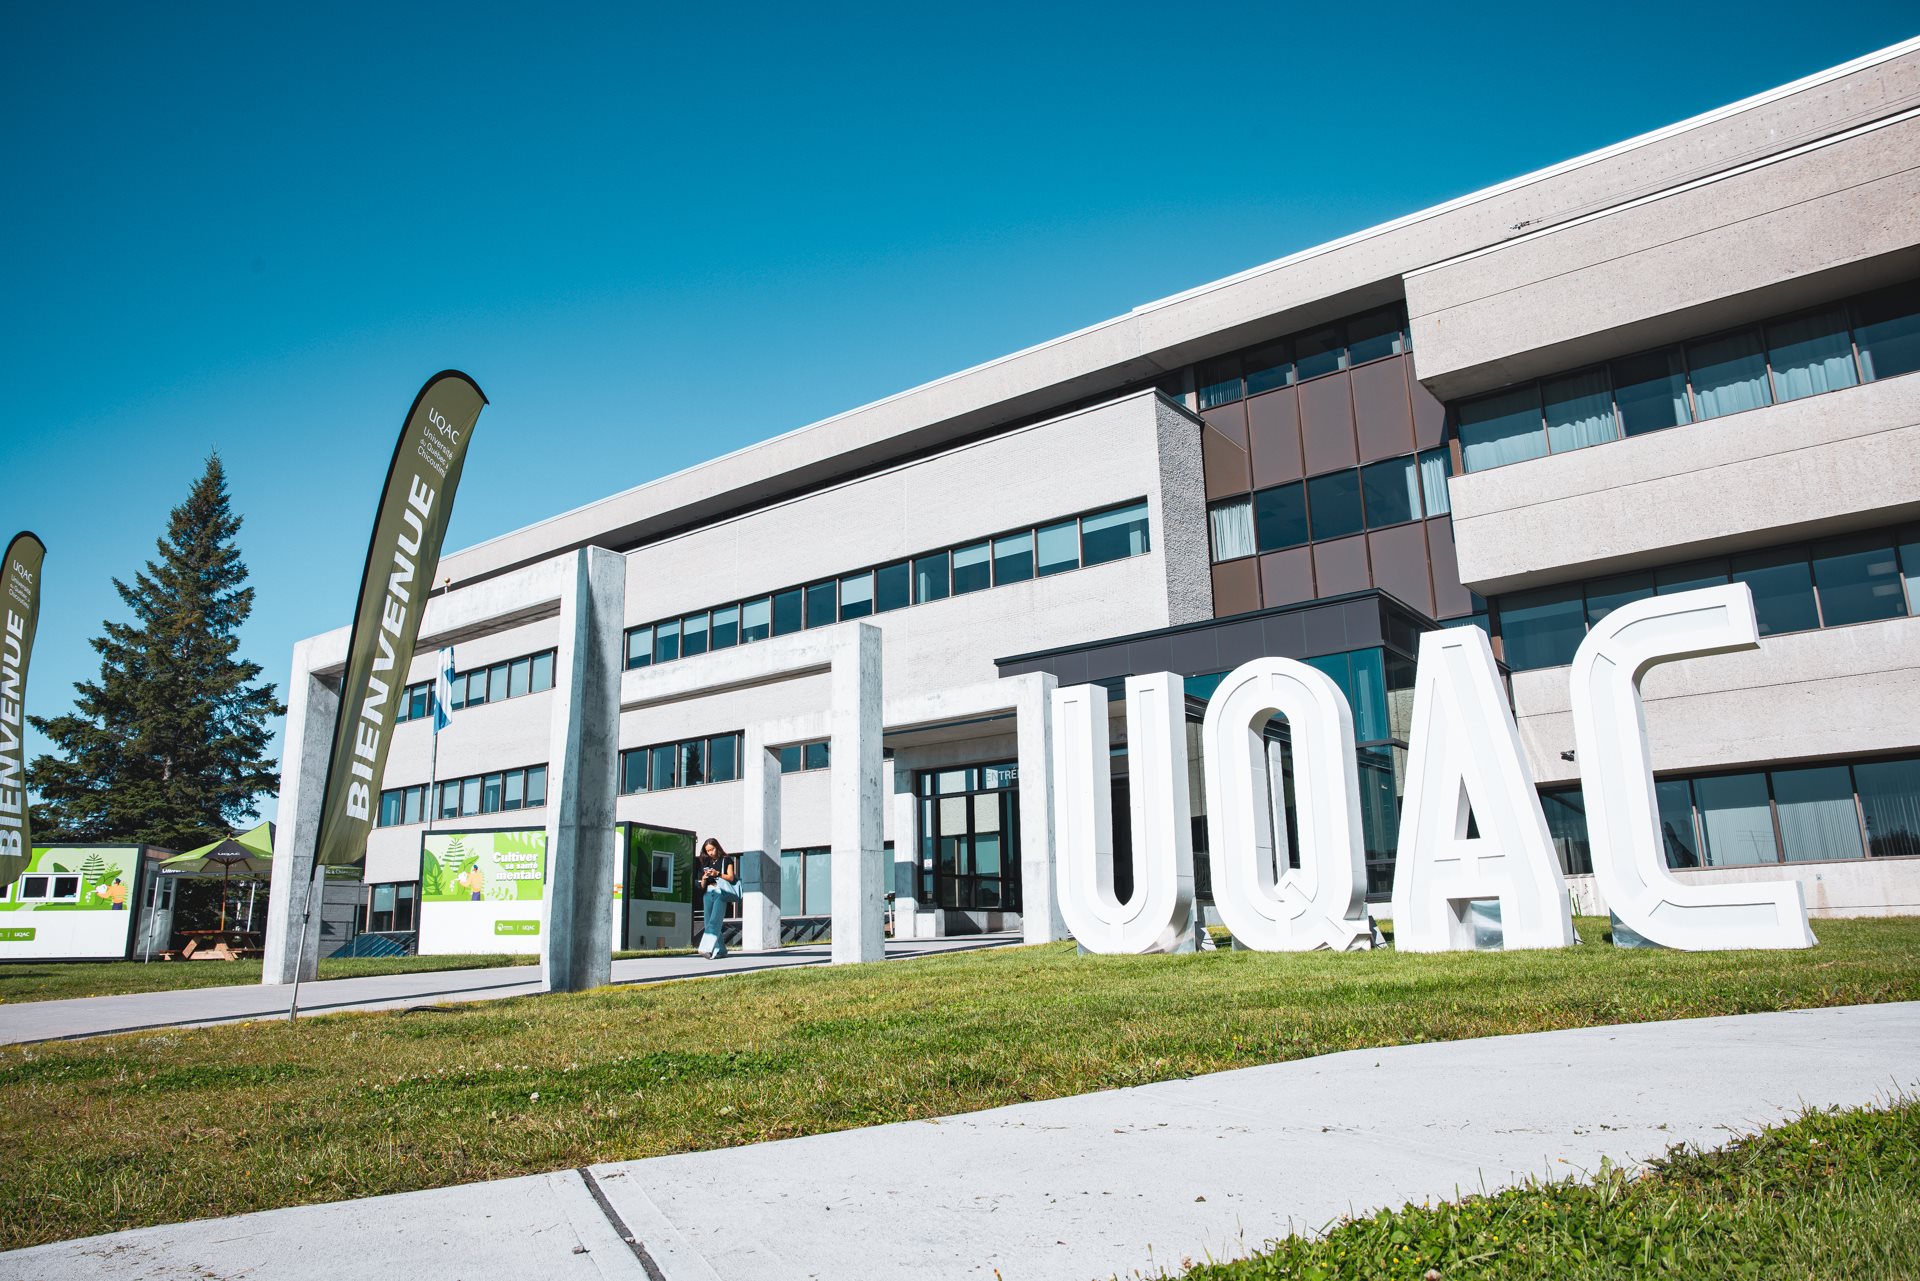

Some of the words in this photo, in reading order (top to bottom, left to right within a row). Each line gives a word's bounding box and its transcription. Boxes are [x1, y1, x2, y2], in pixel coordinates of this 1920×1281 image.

[423, 426, 453, 460] Université
[429, 407, 460, 445] UQAC
[417, 445, 447, 479] Chicoutimi
[13, 560, 32, 584] UQAC
[346, 473, 436, 823] BIENVENUE
[0, 609, 24, 857] BIENVENUE
[1052, 583, 1813, 953] UQAC
[494, 852, 538, 862] Cultiver
[496, 870, 541, 880] mentale
